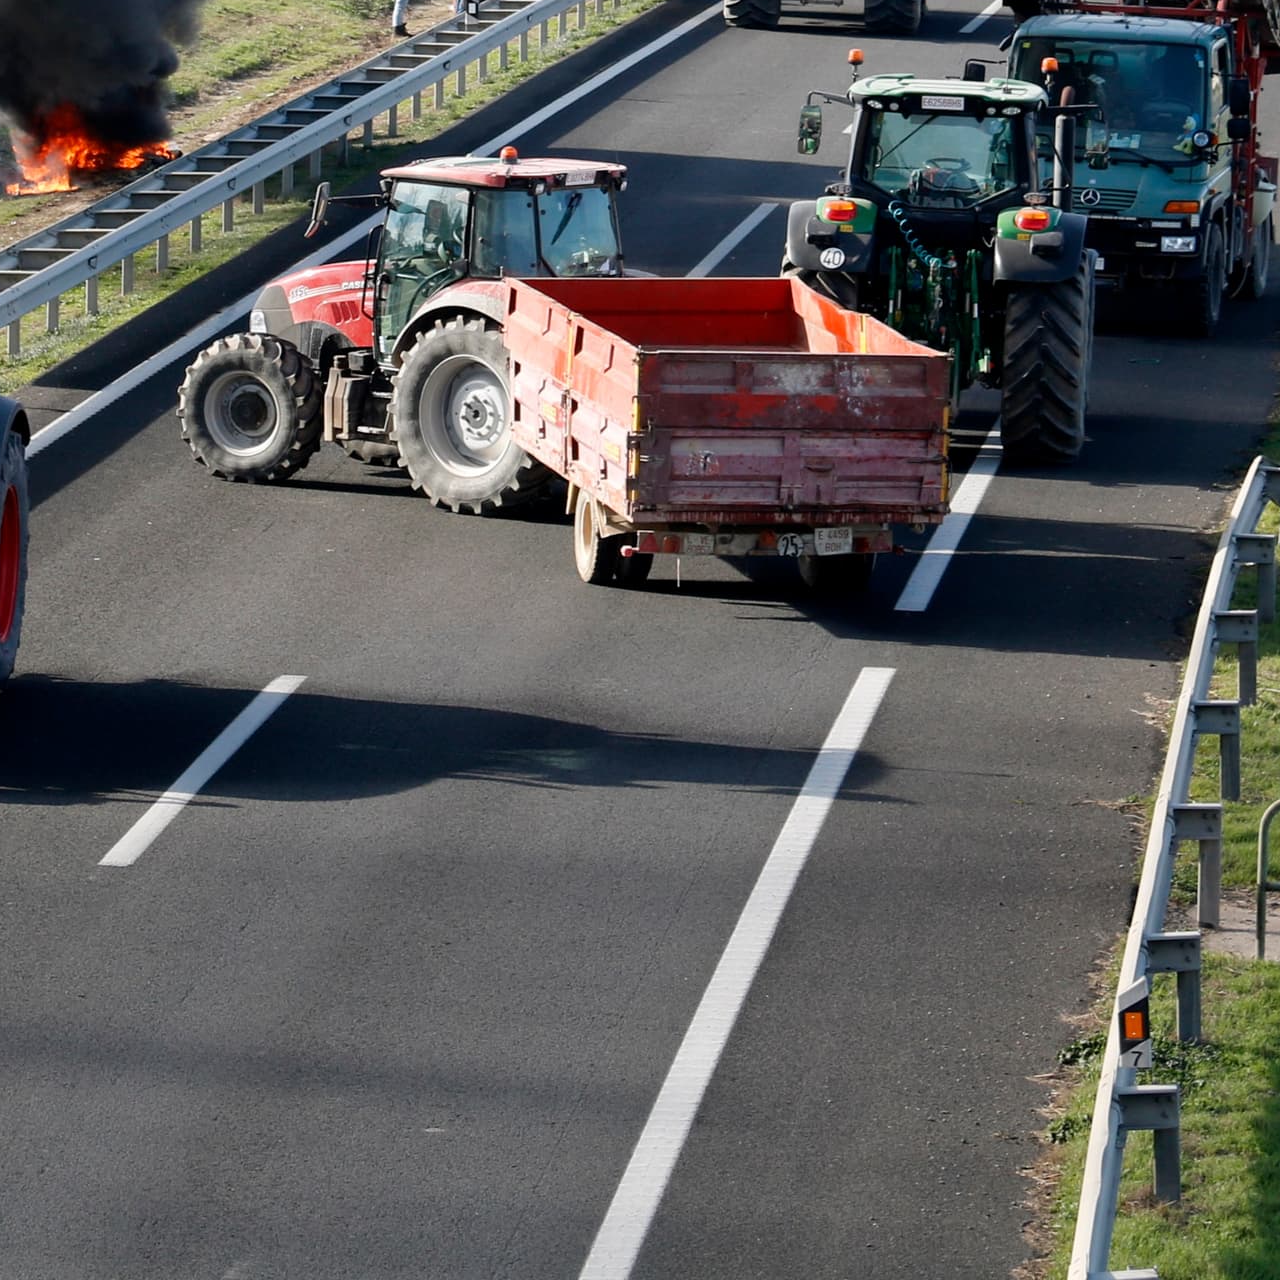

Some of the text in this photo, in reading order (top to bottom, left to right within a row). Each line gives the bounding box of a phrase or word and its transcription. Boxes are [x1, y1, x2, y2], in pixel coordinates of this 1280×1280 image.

[822, 250, 842, 266] 40
[818, 530, 824, 540] E
[782, 534, 799, 555] 25
[1130, 1050, 1143, 1067] 7
